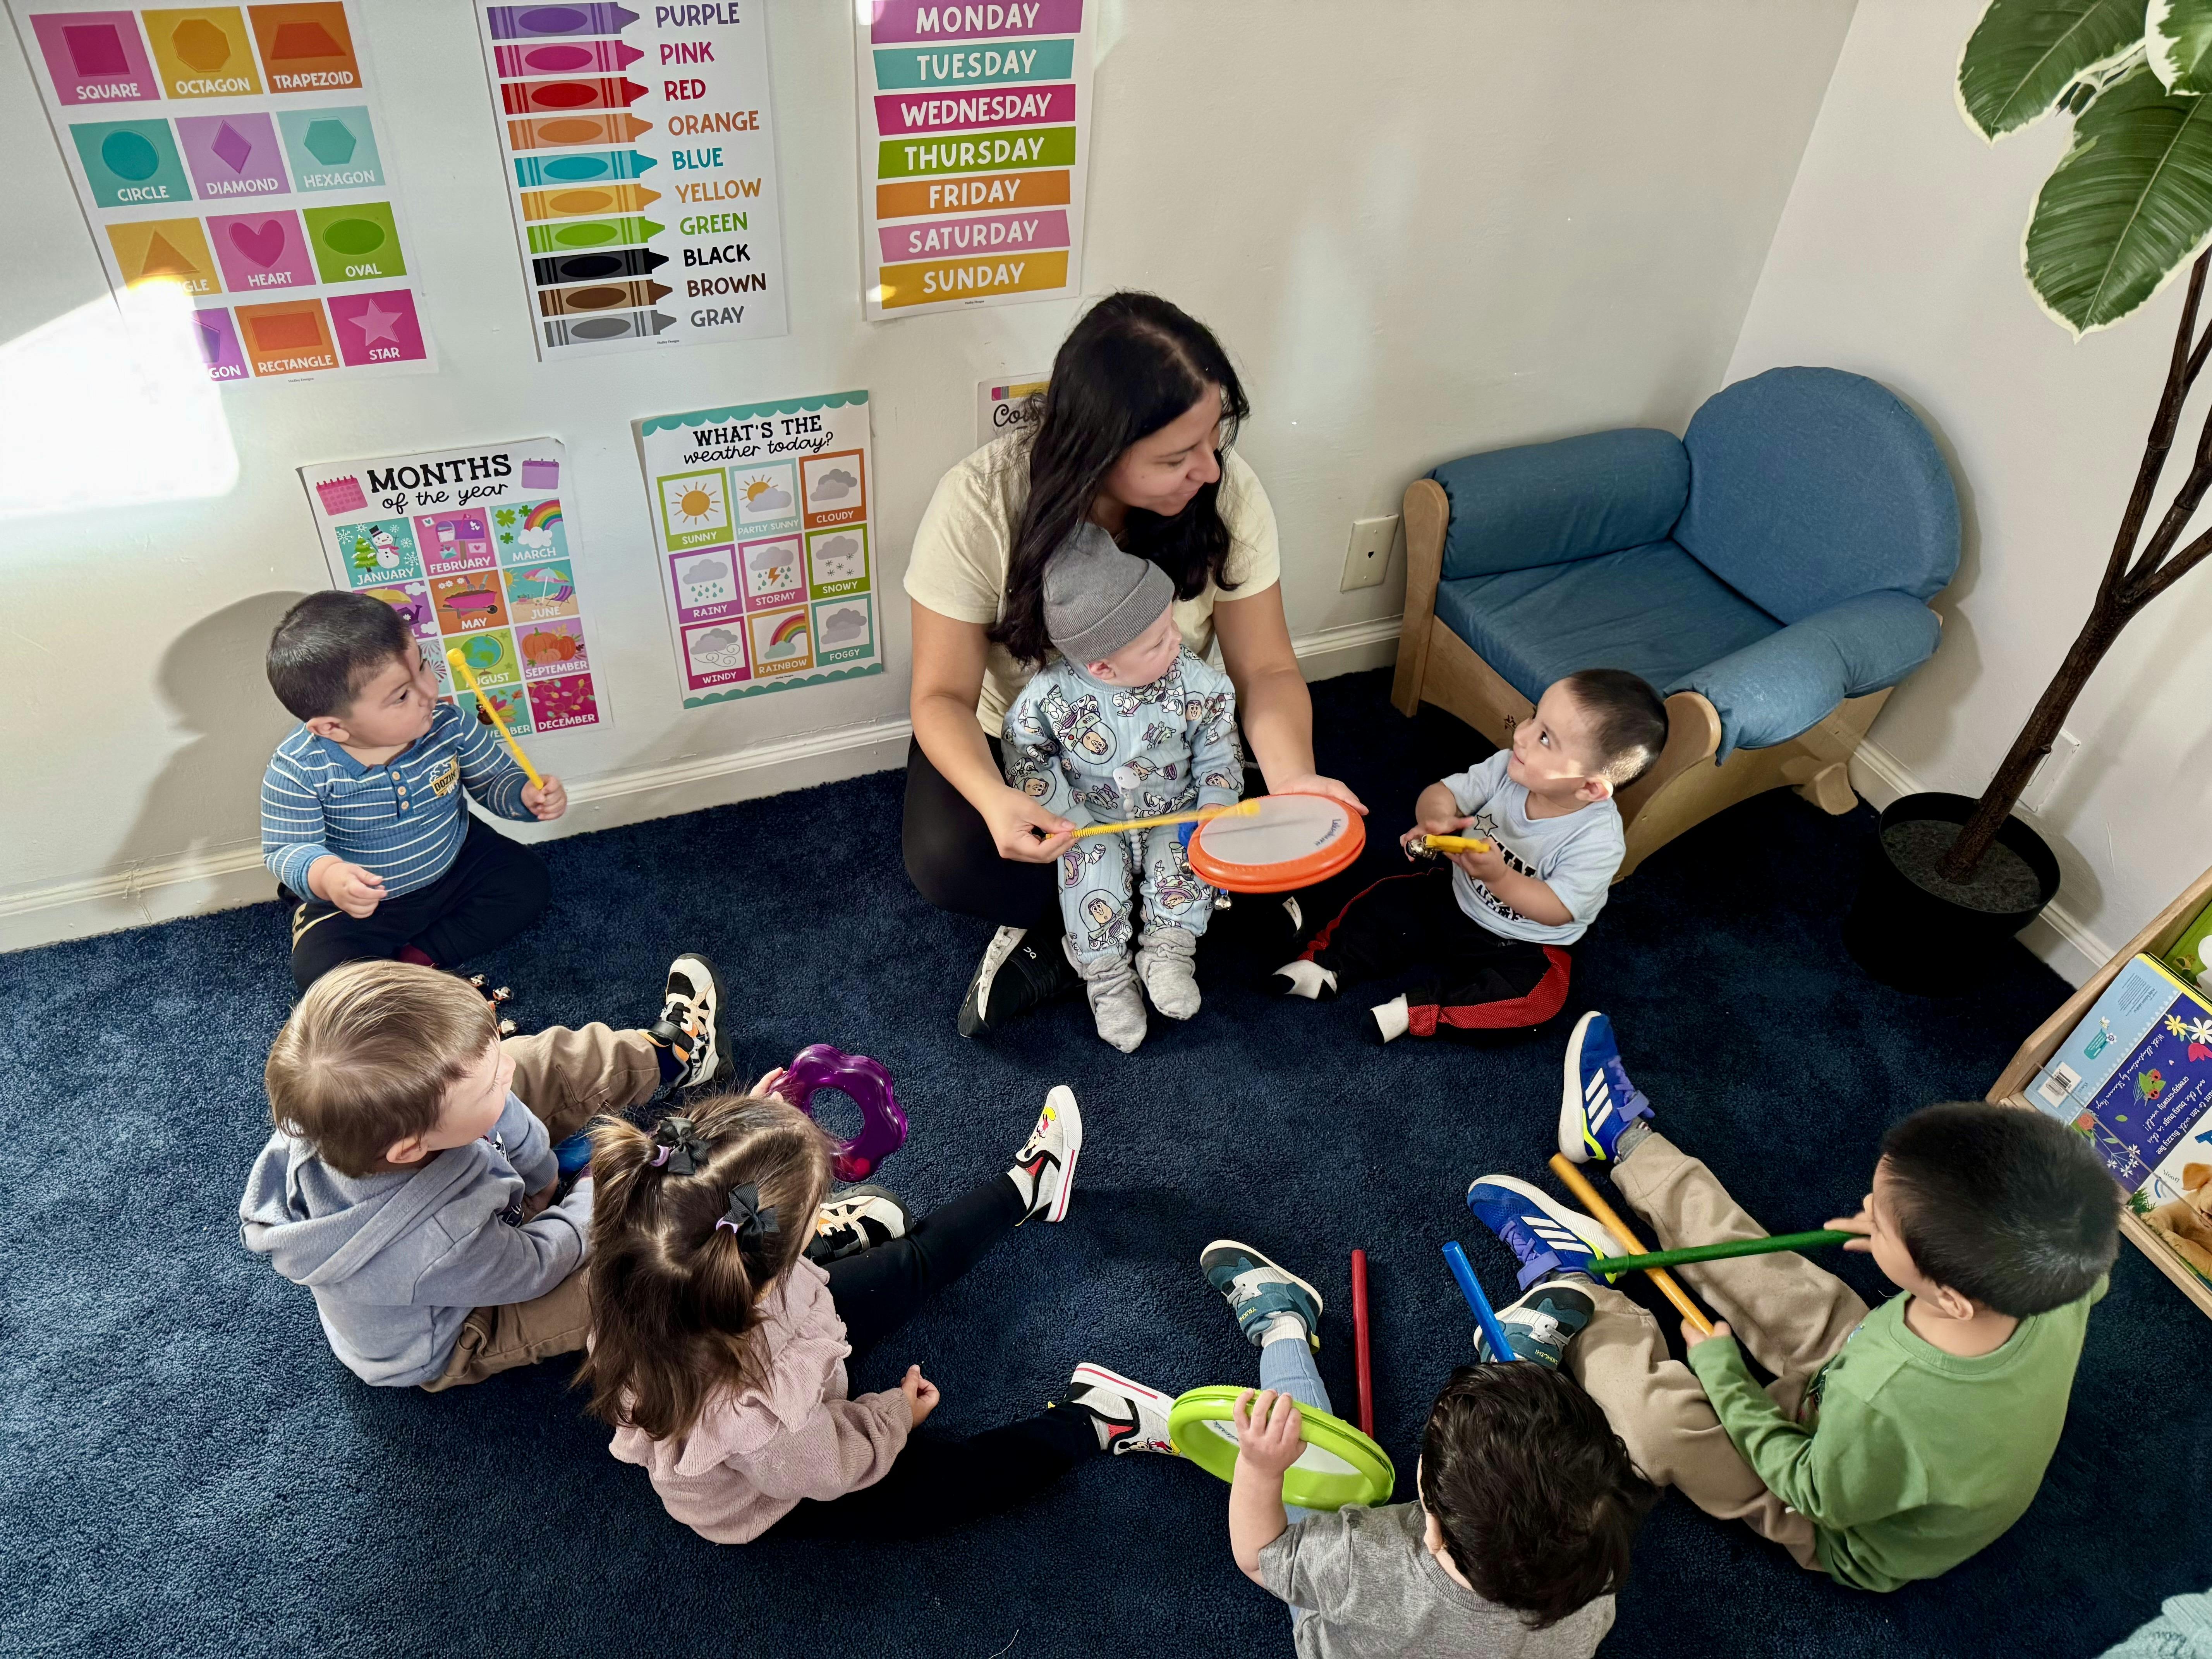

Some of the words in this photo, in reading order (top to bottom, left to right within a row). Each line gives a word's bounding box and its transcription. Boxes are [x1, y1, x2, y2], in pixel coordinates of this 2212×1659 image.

[656, 3, 740, 28] PURPLE
[916, 2, 1040, 34] MONDAY
[660, 41, 715, 65] PINK
[917, 49, 1037, 81] TUESDAY
[176, 78, 251, 94] OCTAGON
[273, 71, 353, 88] TRAPEZOID
[76, 83, 141, 100] SQUARE
[665, 80, 706, 101] RED
[900, 93, 1052, 127] WEDNESDAY
[668, 111, 760, 135] ORANGE
[672, 148, 724, 170] BLUE
[905, 137, 1044, 171] THURSDAY
[206, 178, 278, 195] DIAMOND
[303, 170, 375, 188] HEXAGON
[117, 185, 170, 202] CIRCLE
[675, 178, 762, 203] YELLOW
[929, 179, 1020, 209] FRIDAY
[680, 212, 748, 235] GREEN
[908, 219, 1039, 254] SATURDAY
[684, 244, 751, 267] BLACK
[247, 271, 292, 286] HEART
[345, 264, 382, 277] OVAL
[924, 262, 1025, 294] SUNDAY
[687, 273, 766, 297] BROWN
[691, 306, 745, 327] GRAY
[369, 347, 400, 360] STAR
[258, 355, 333, 373] RECTANGLE
[693, 421, 773, 447] WHAT'S
[781, 415, 823, 435] THE
[684, 445, 761, 465] weather
[767, 431, 833, 454] today?
[367, 454, 512, 493] MONTHS
[382, 493, 409, 514] of
[416, 489, 449, 507] the
[458, 482, 508, 506] year
[816, 511, 854, 523] CLOUDY
[737, 524, 768, 535] PARTLY
[771, 519, 799, 531] SUNNY
[682, 531, 717, 544] SUNNY
[512, 548, 556, 562] MARCH
[429, 556, 491, 574] FEBRUARY
[357, 568, 414, 585] JANUARY
[823, 581, 858, 593] SNOWY
[756, 591, 795, 606] STORMY
[531, 606, 561, 620] JUNE
[693, 605, 728, 618] RAINY
[461, 617, 487, 630] MAY
[830, 648, 860, 661] FOGGY
[525, 661, 588, 678] SEPTEMBER
[759, 659, 807, 674] RAINBOW
[702, 672, 737, 684] WINDY
[538, 714, 596, 731] DECEMBER
[2151, 1034, 2164, 1048] With
[2126, 1046, 2153, 1074] illustrations
[2119, 1072, 2130, 1081] by
[2157, 1076, 2189, 1110] creepy-crawly
[2195, 1079, 2205, 1095] and
[2185, 1091, 2197, 1102] the
[2172, 1101, 2187, 1114] busy
[2190, 1108, 2200, 1117] ten
[2142, 1111, 2159, 1131] world!
[2163, 1113, 2176, 1127] bugs
[2178, 1116, 2191, 1133] with
[2147, 1132, 2160, 1144] this
[2162, 1130, 2181, 1147] Buzzy
[2156, 1145, 2167, 1155] Bee
